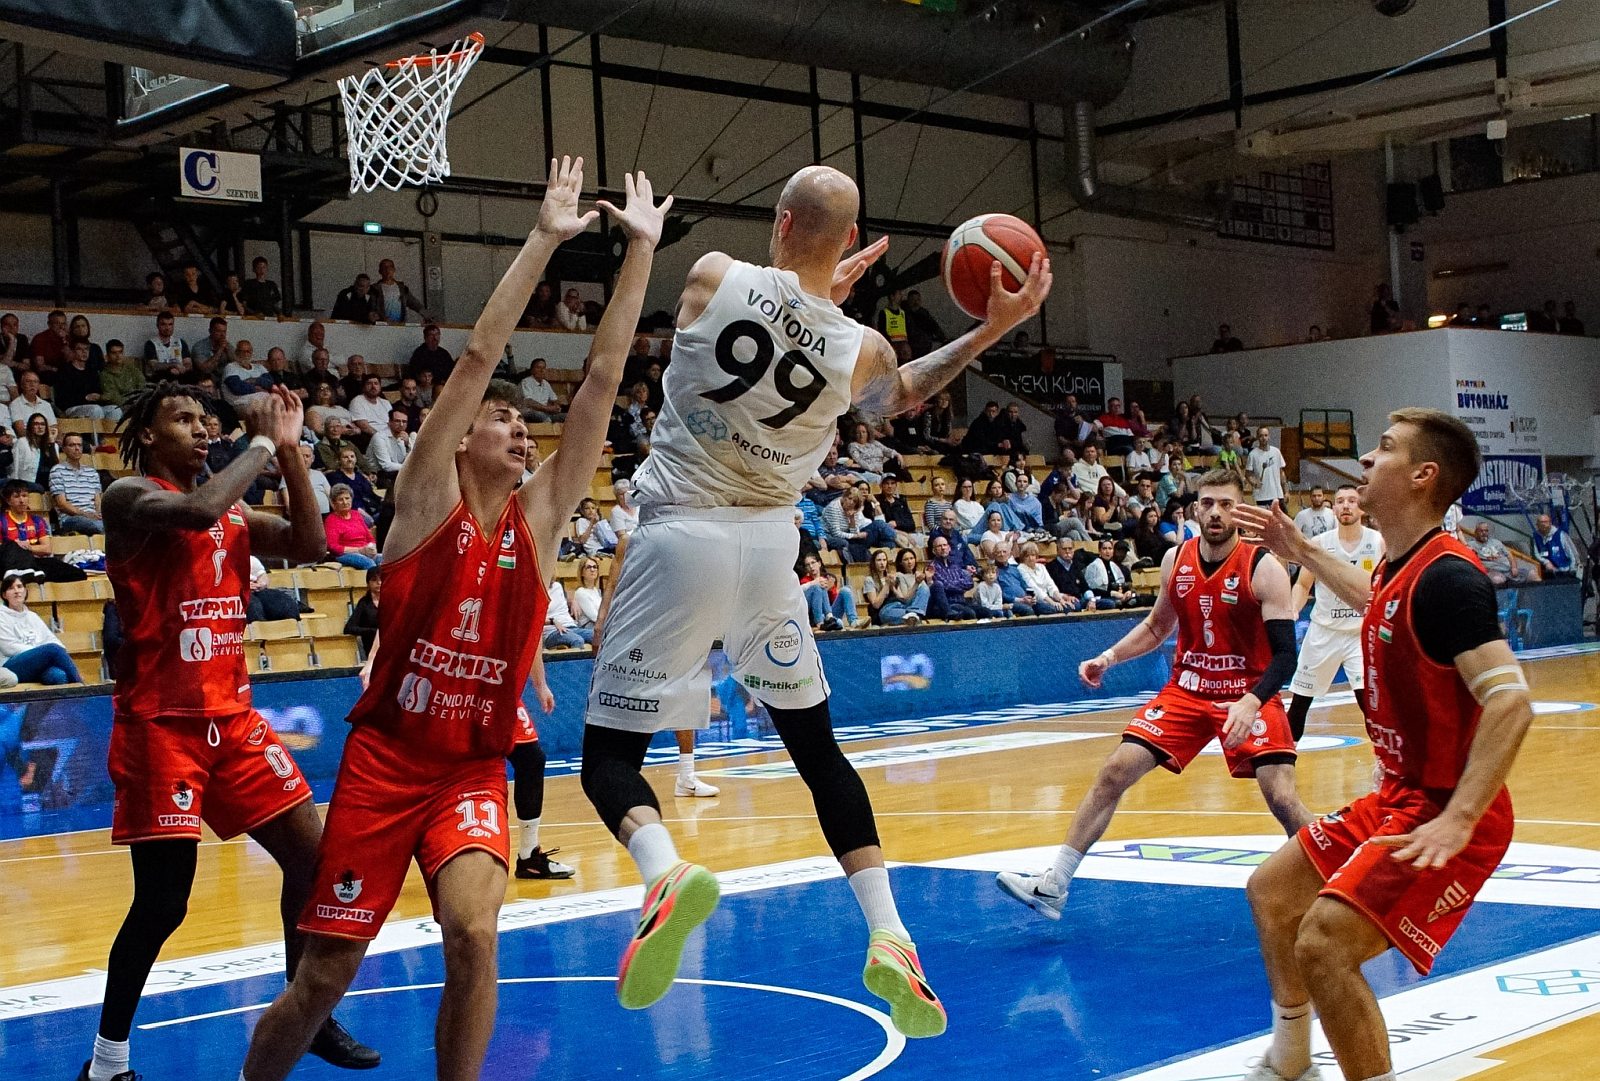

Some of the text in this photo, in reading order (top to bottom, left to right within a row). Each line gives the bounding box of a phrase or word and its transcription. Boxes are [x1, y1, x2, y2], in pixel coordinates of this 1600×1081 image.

[184, 151, 219, 195] C
[226, 189, 259, 199] SZEKTOR
[697, 319, 828, 430] 99
[1052, 371, 1101, 395] KÚRIA
[1457, 389, 1508, 410] BÚTORHÁZ
[731, 432, 792, 466] ARCONIC
[451, 598, 483, 642] 11
[602, 662, 668, 681] STAN AHUJA
[1223, 678, 1247, 689] PLUS
[464, 694, 494, 713] PLUS
[516, 706, 530, 728] 9
[264, 744, 293, 778] 0
[455, 799, 500, 835] 11
